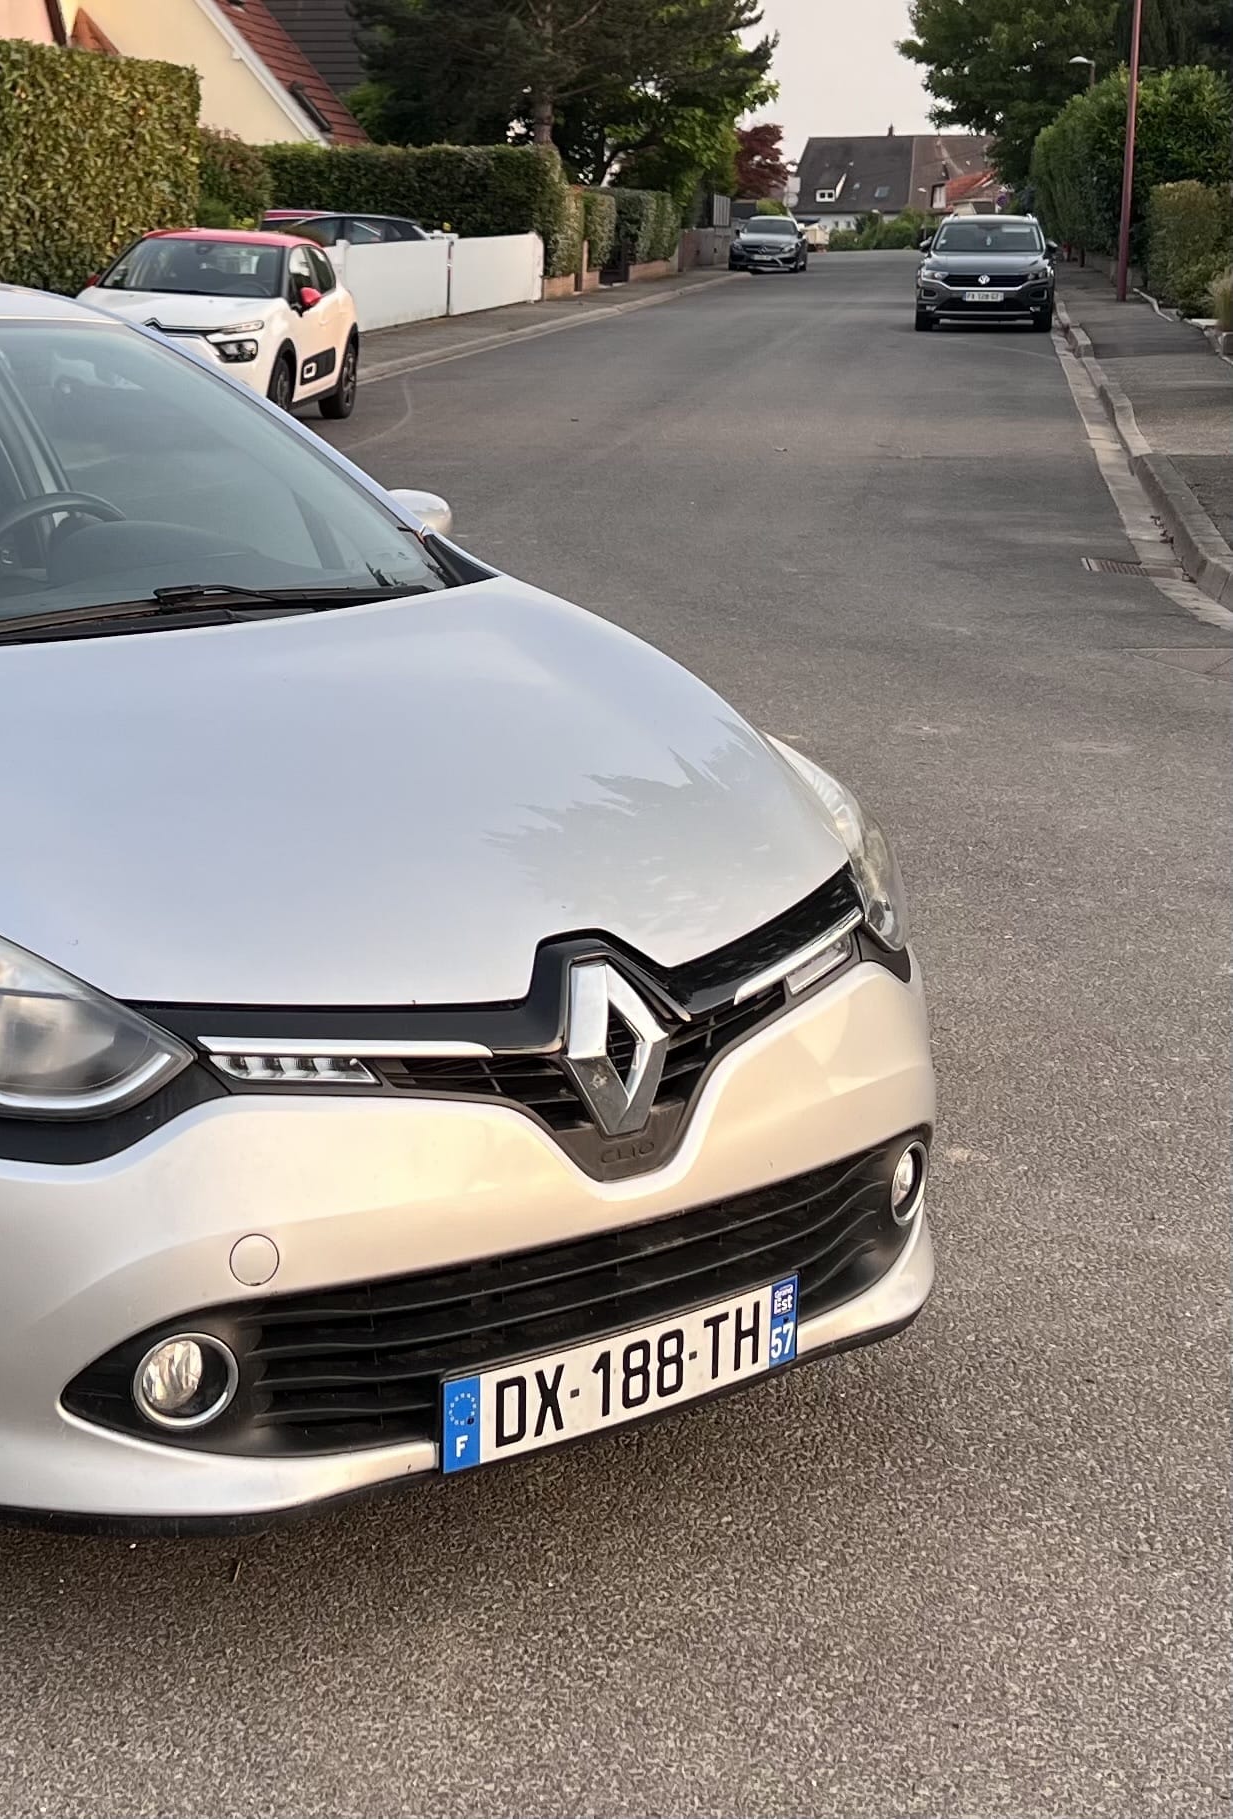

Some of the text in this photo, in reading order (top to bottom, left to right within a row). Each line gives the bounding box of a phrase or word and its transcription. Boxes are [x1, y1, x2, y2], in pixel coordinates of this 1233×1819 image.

[600, 1141, 655, 1163] CLIO
[774, 1294, 793, 1315] Est
[771, 1321, 794, 1359] 57
[495, 1300, 761, 1448] DX-188-TH
[455, 1434, 468, 1458] F
